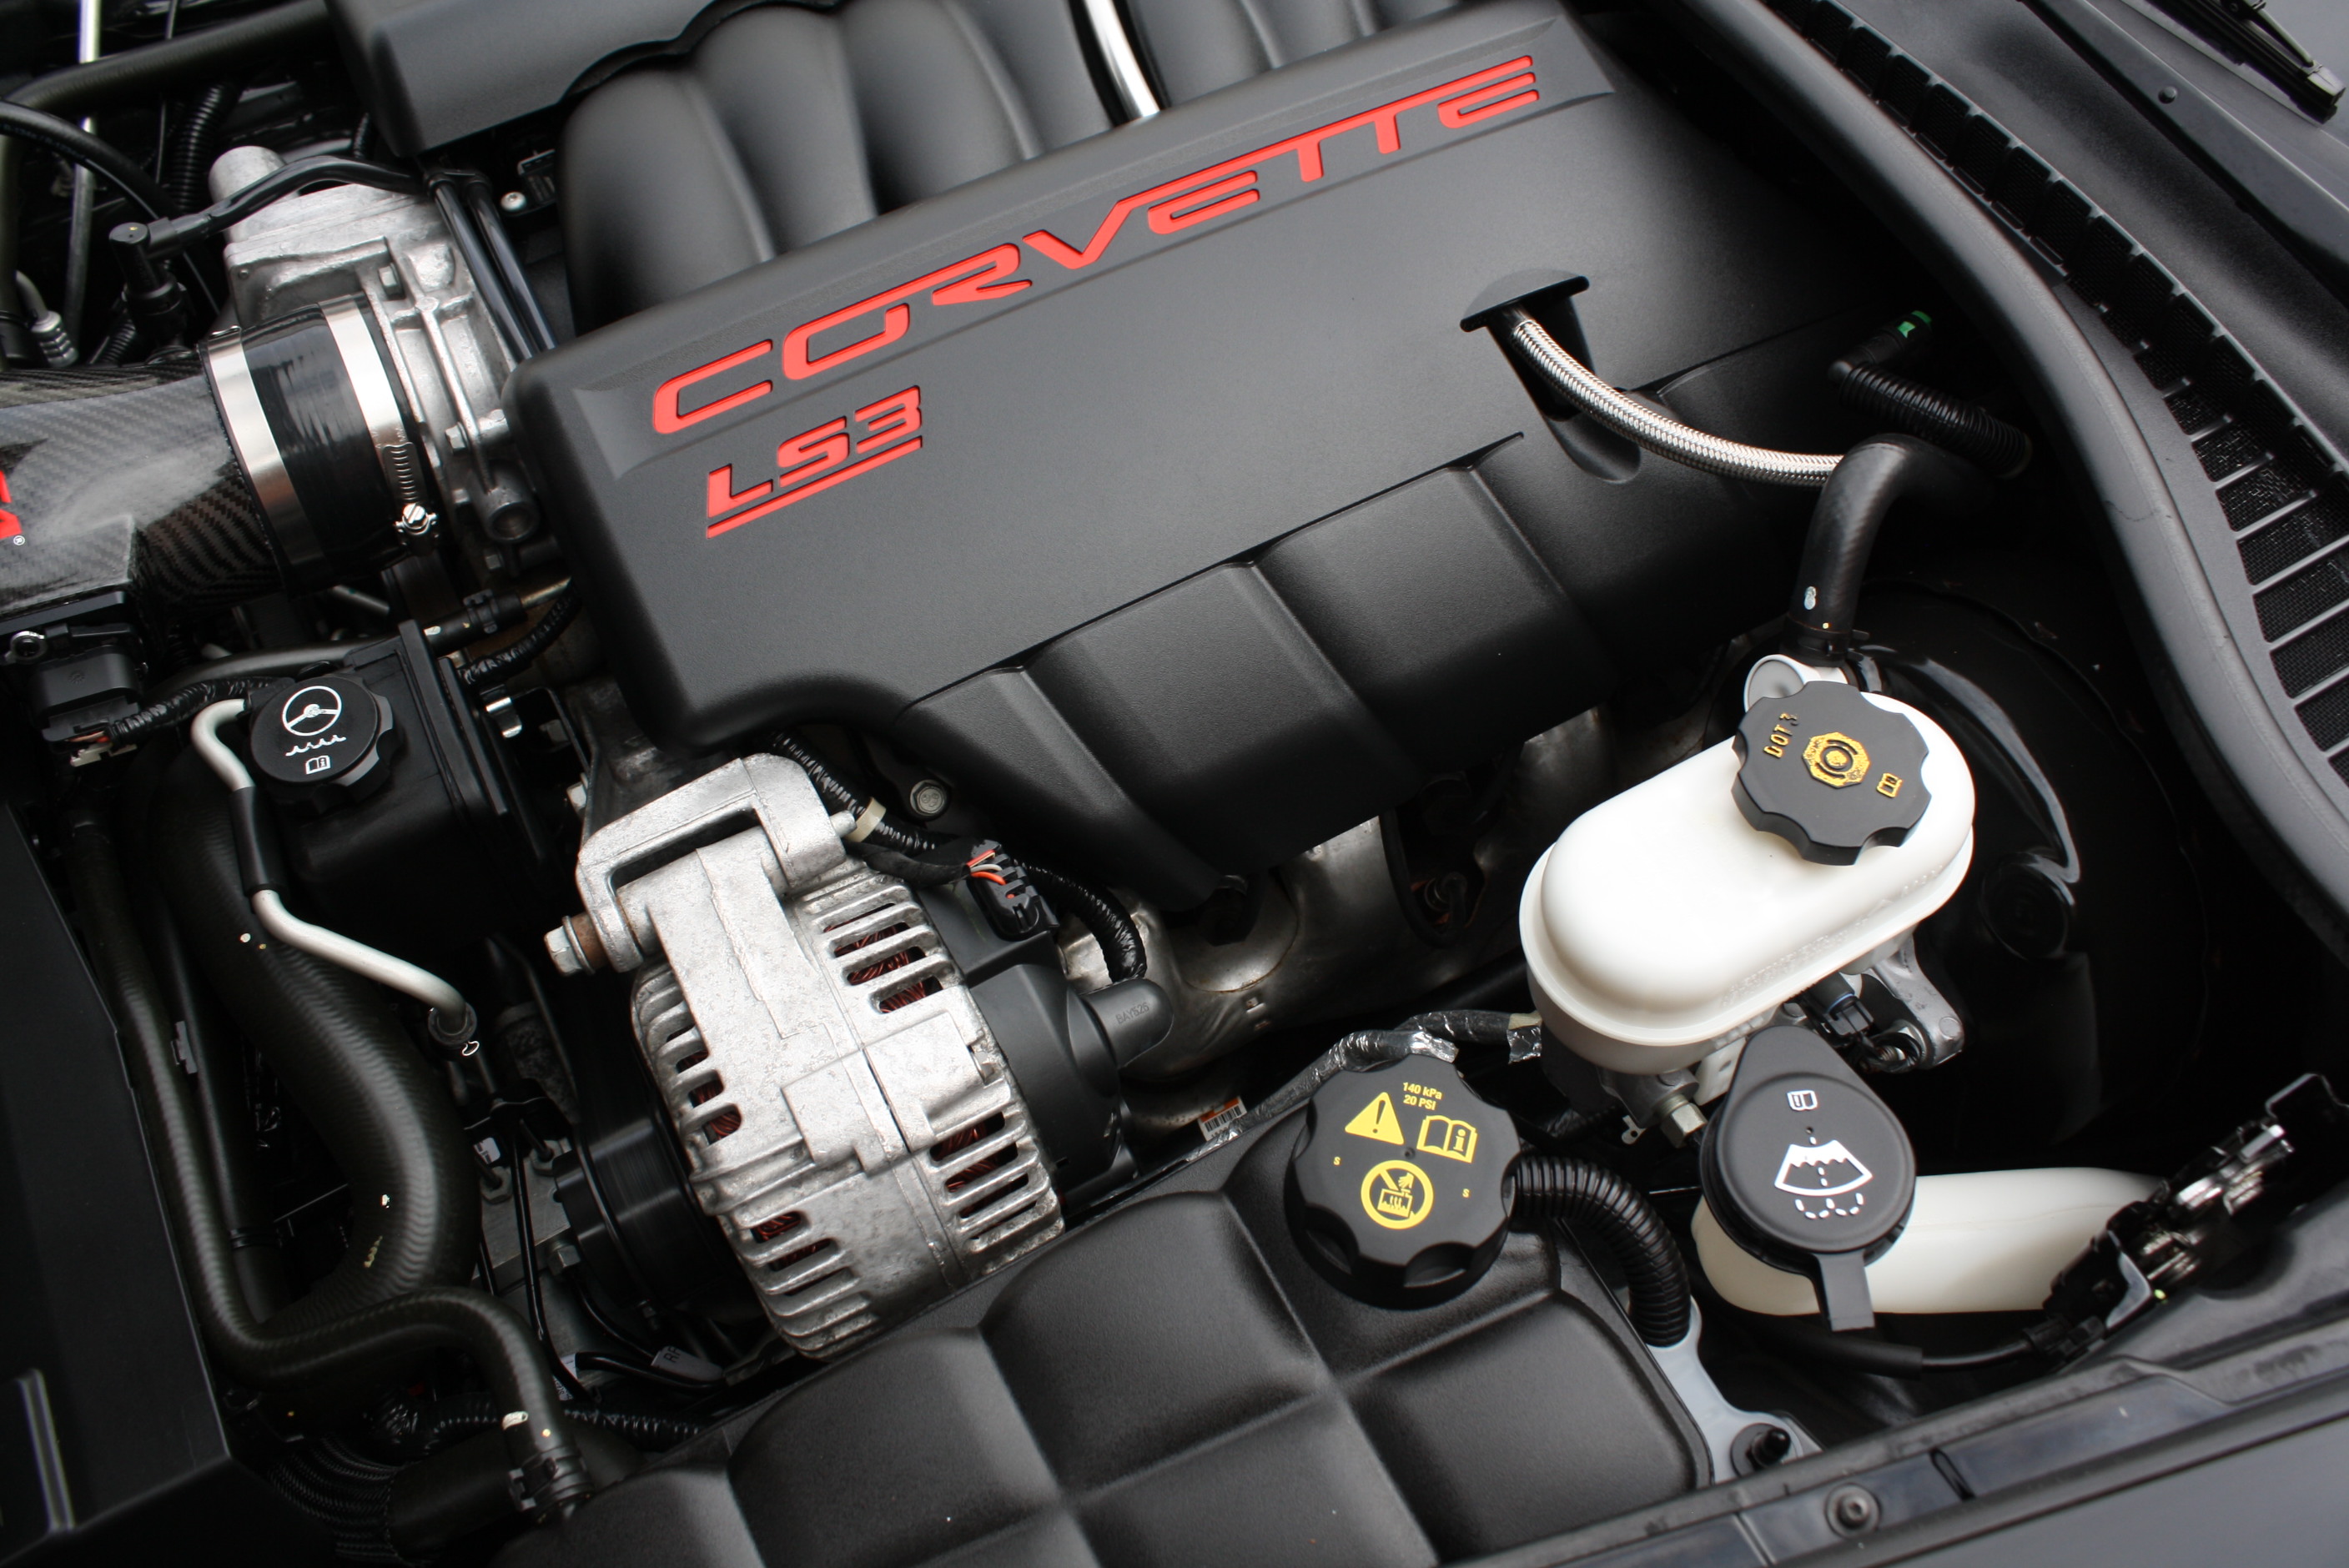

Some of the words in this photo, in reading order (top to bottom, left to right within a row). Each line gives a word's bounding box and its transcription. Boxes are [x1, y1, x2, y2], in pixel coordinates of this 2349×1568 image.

[652, 55, 1541, 435] CORVETTE
[706, 386, 922, 518] LS3
[1763, 724, 1793, 759] DOT
[1402, 1082, 1421, 1094] 140
[1422, 1086, 1442, 1100] kPa
[1403, 1094, 1418, 1106] 20
[1418, 1097, 1436, 1111] PSI
